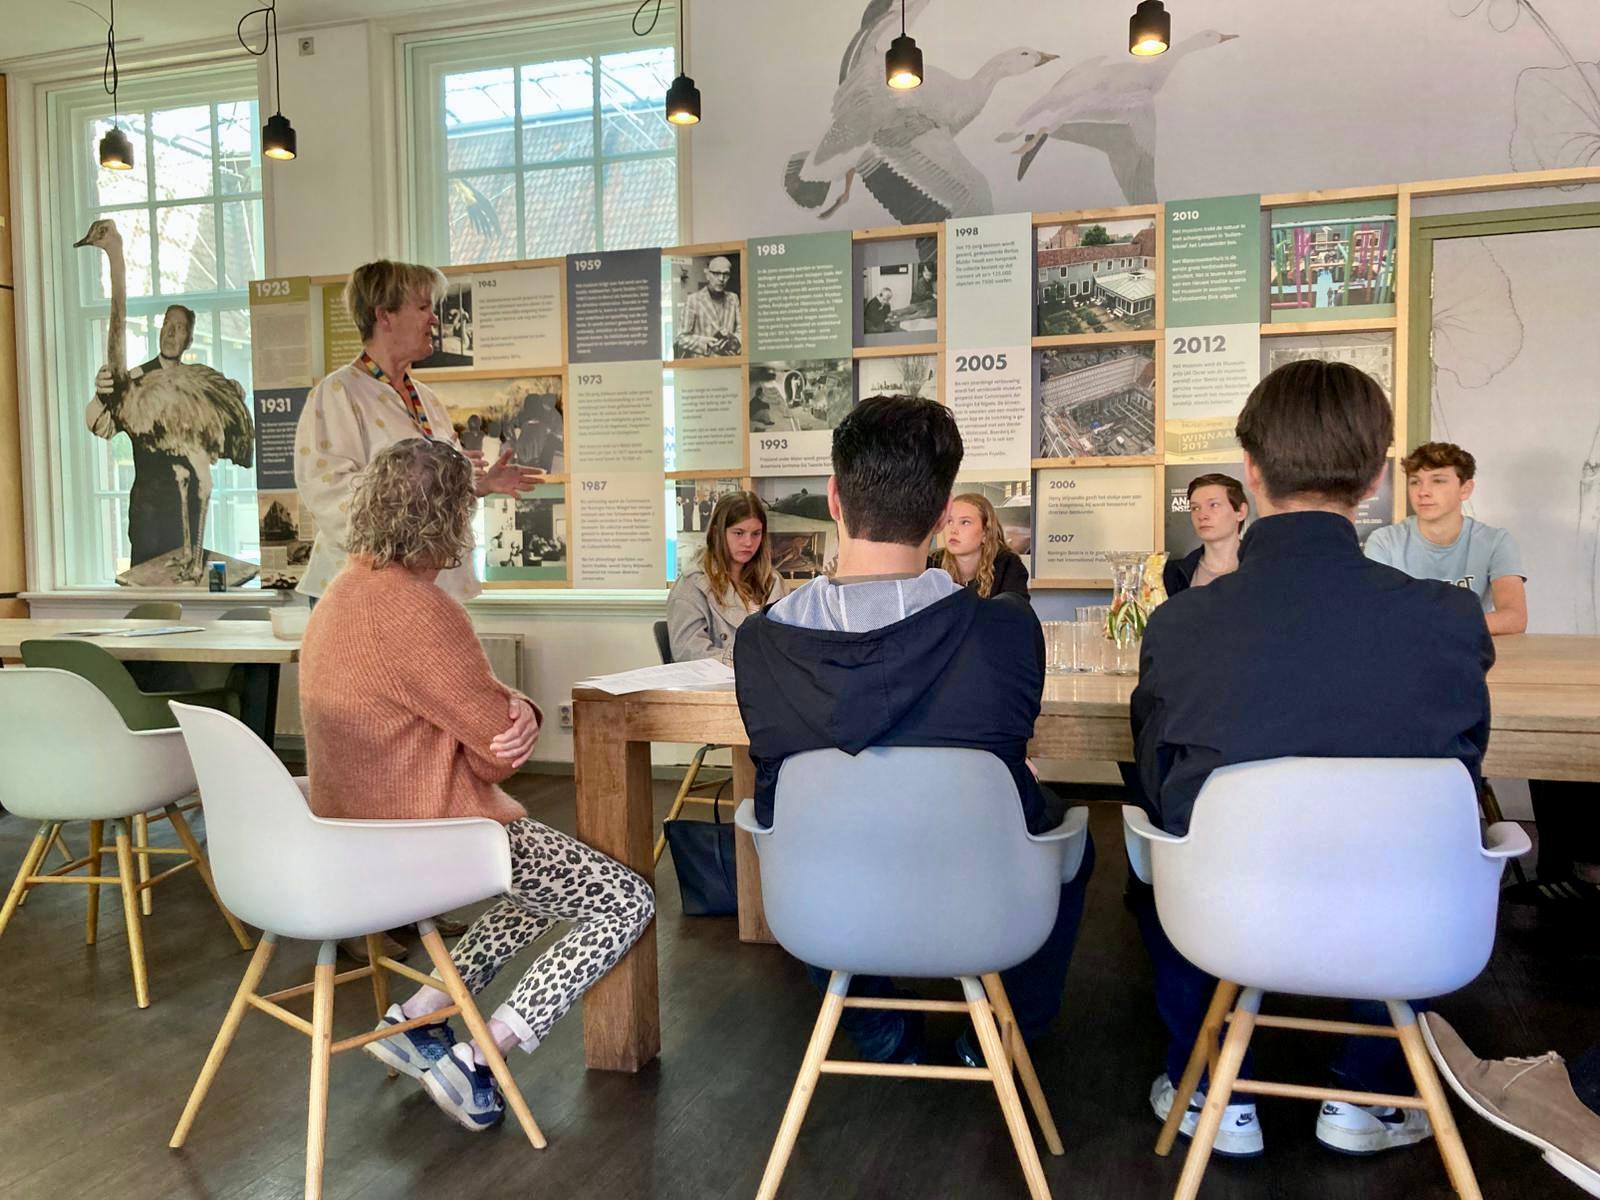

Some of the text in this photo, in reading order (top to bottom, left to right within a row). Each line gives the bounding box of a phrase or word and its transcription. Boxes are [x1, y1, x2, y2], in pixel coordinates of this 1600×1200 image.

[1173, 211, 1199, 221] 2010
[956, 227, 978, 237] 1998
[757, 244, 785, 256] 1988
[575, 260, 601, 271] 1959
[256, 281, 290, 297] 1923
[1173, 336, 1226, 354] 2012
[955, 354, 1007, 372] 2005
[578, 375, 602, 385] 1973
[261, 398, 291, 413] 1931
[1183, 431, 1232, 442] WINNAA
[760, 440, 787, 449] 1993
[1182, 441, 1208, 450] 2012
[582, 481, 607, 490] 1987
[1050, 481, 1076, 489] 2006
[1048, 534, 1074, 542] 2007
